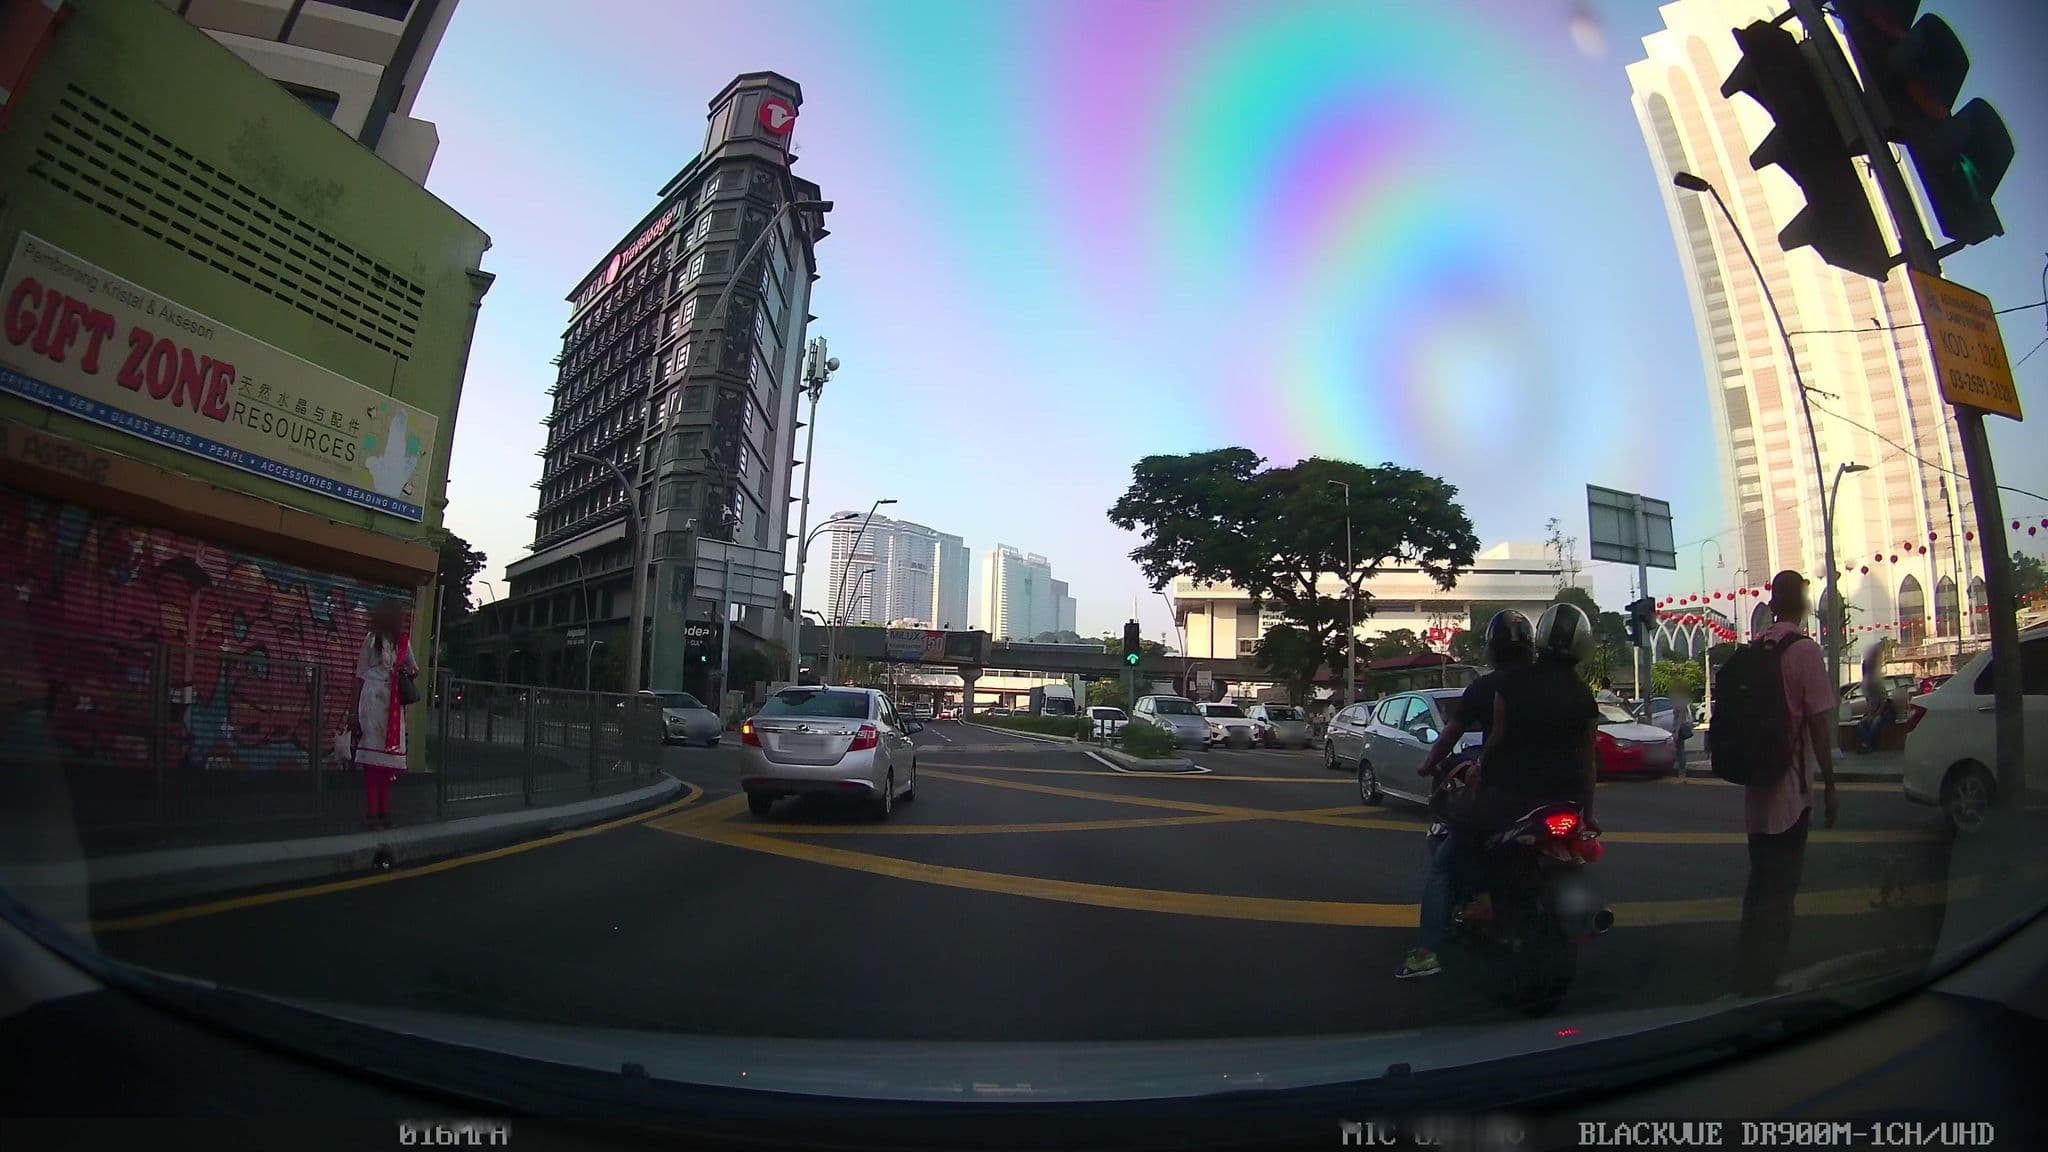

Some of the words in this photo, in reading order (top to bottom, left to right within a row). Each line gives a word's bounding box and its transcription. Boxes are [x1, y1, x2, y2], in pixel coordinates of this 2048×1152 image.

[103, 281, 143, 310] Kristal
[147, 300, 155, 315] &
[159, 304, 214, 341] Aksesori
[4, 277, 115, 375] GIFT
[117, 326, 236, 423] ZONE
[232, 401, 356, 462] RESOURCES
[238, 376, 360, 434] 天然水晶与配件
[111, 411, 148, 432] GLASS
[153, 426, 192, 446] BEADS
[209, 444, 244, 464] PEARL
[260, 461, 333, 490] ACCESSORIES
[346, 488, 388, 508] BEADING
[392, 502, 408, 515] DIY
